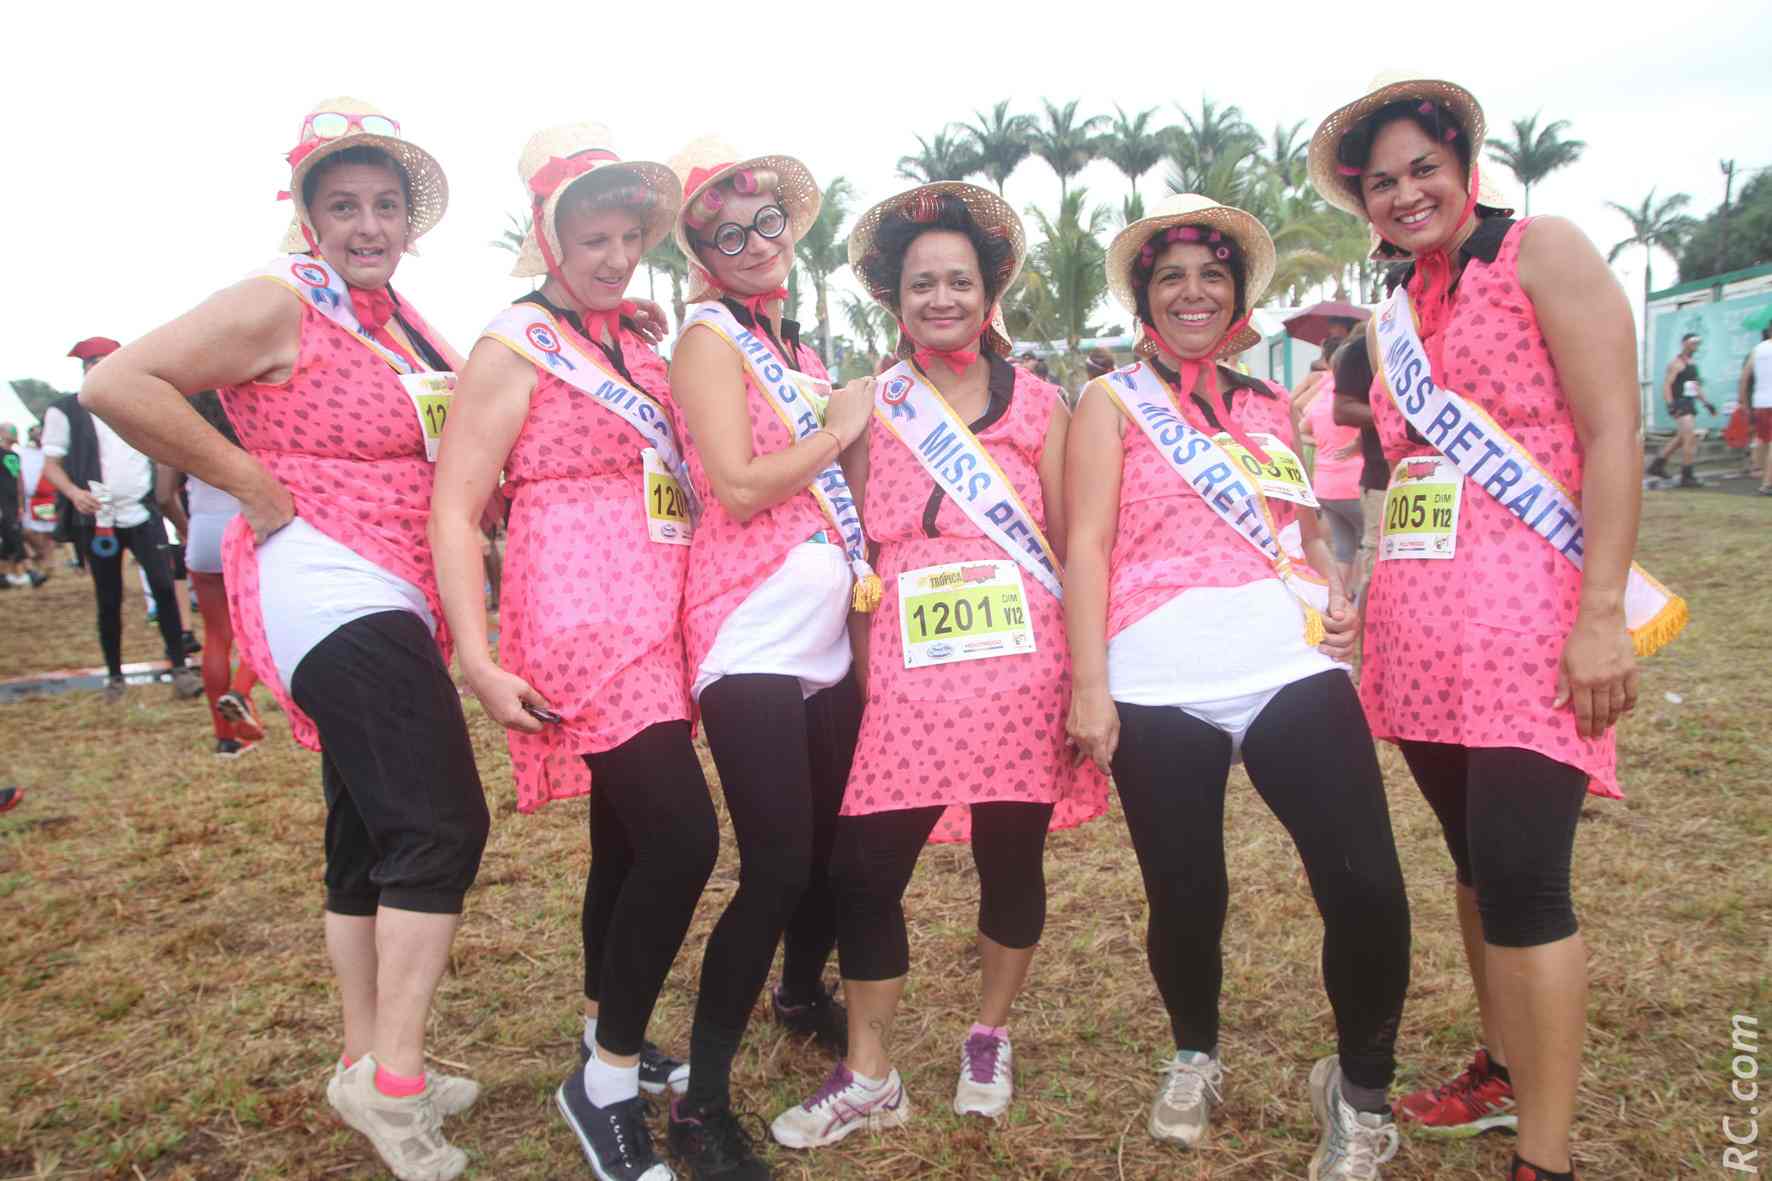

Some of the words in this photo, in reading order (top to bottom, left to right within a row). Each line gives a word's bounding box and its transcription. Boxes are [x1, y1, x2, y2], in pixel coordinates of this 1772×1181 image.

[1387, 331, 1434, 414] MISS
[1137, 402, 1211, 464] MISS
[918, 421, 991, 502] MISS
[1433, 508, 1452, 528] V12
[1434, 494, 1452, 503] DIM
[912, 595, 993, 637] 1201
[1004, 607, 1025, 625] V12
[1002, 593, 1018, 604] DIM
